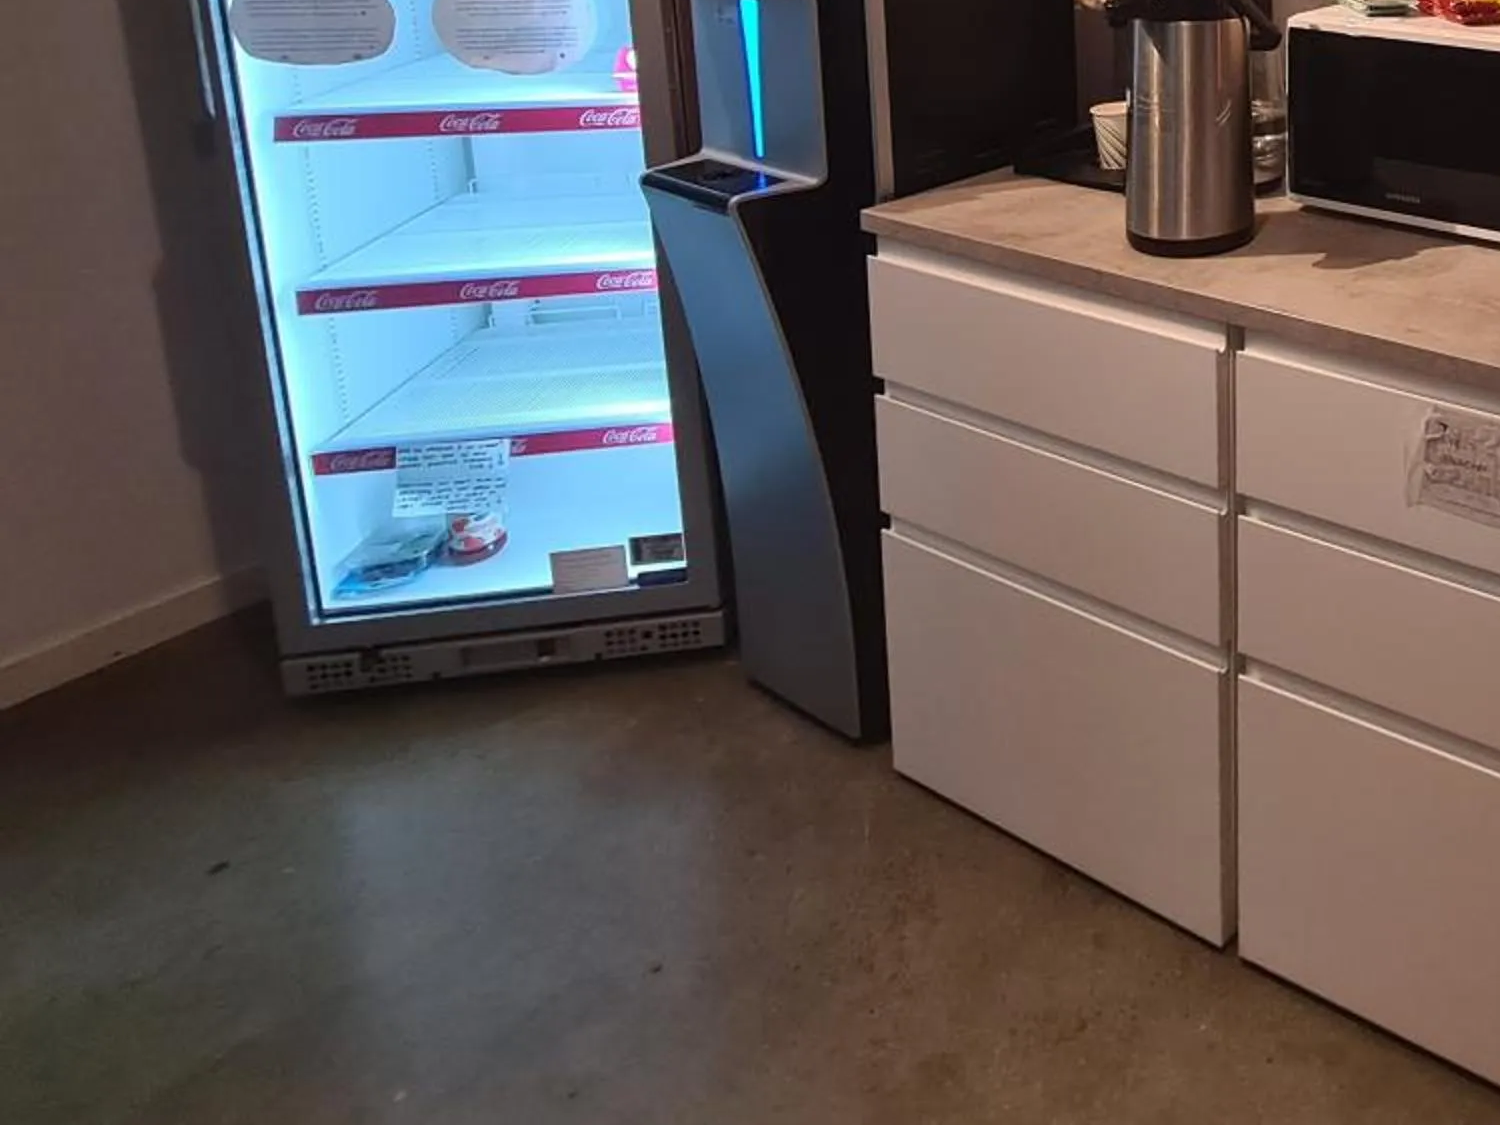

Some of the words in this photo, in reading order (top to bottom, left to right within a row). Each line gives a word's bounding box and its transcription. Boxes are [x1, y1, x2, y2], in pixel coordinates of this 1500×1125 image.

[292, 118, 358, 138] Coca-Cola
[439, 112, 503, 132] Coca-Cola
[460, 281, 519, 300] Coca-Cola
[596, 273, 656, 290] Coca-Cola
[315, 291, 378, 311] Coca-Cola
[602, 426, 658, 445] Coca-Cola
